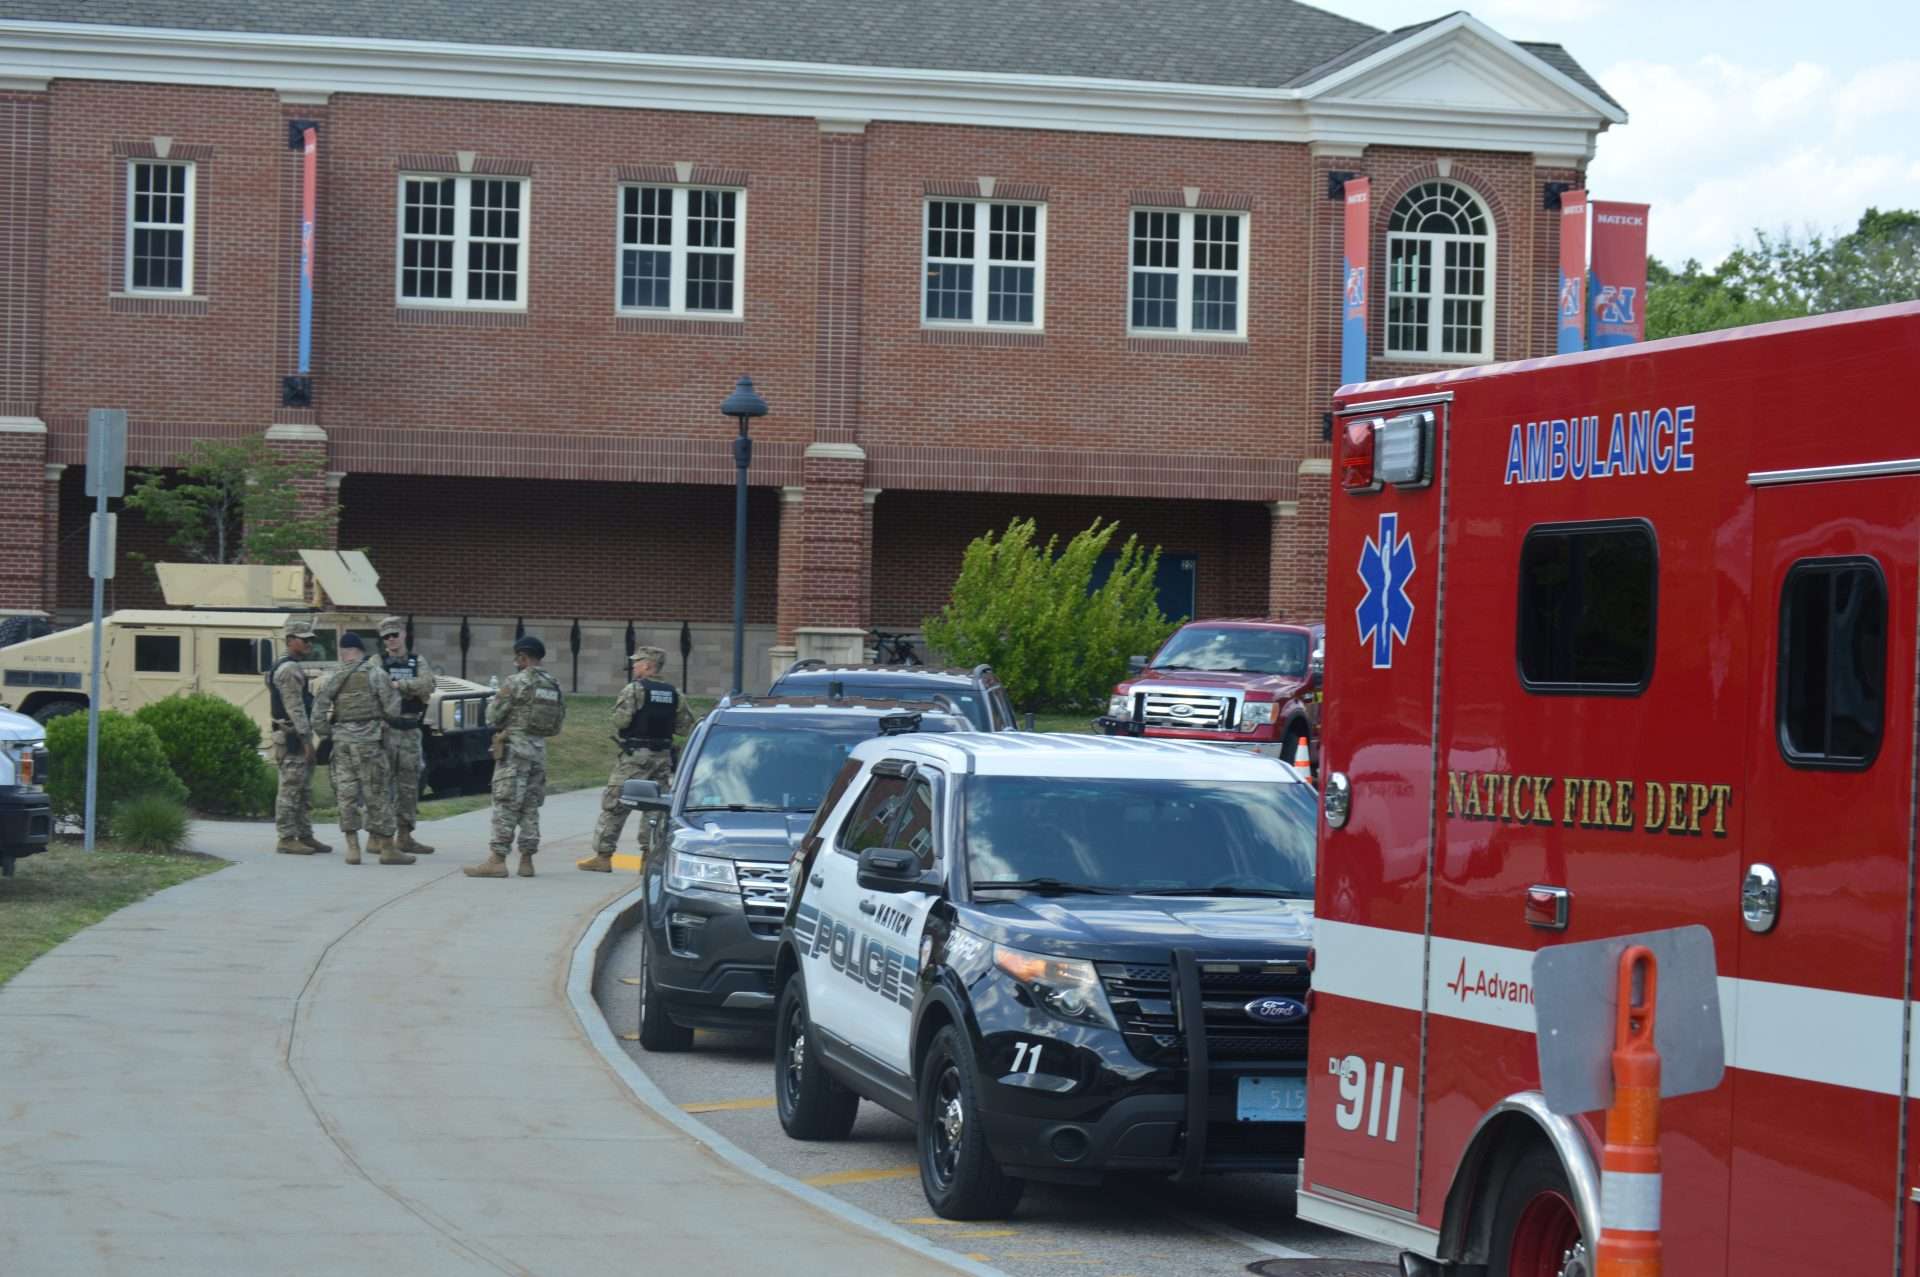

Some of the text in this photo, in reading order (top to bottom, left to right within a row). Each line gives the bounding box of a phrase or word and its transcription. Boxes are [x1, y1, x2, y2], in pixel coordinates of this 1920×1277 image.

[1597, 213, 1643, 225] NATICK
[1504, 405, 1695, 484] AMBULANCE
[1447, 771, 1731, 837] NATICK FIRE DEPT
[875, 903, 914, 938] NATICK
[811, 911, 904, 1004] POLICE
[1260, 998, 1294, 1016] Ford
[1010, 1041, 1043, 1075] 71
[1335, 1054, 1405, 1143] 911
